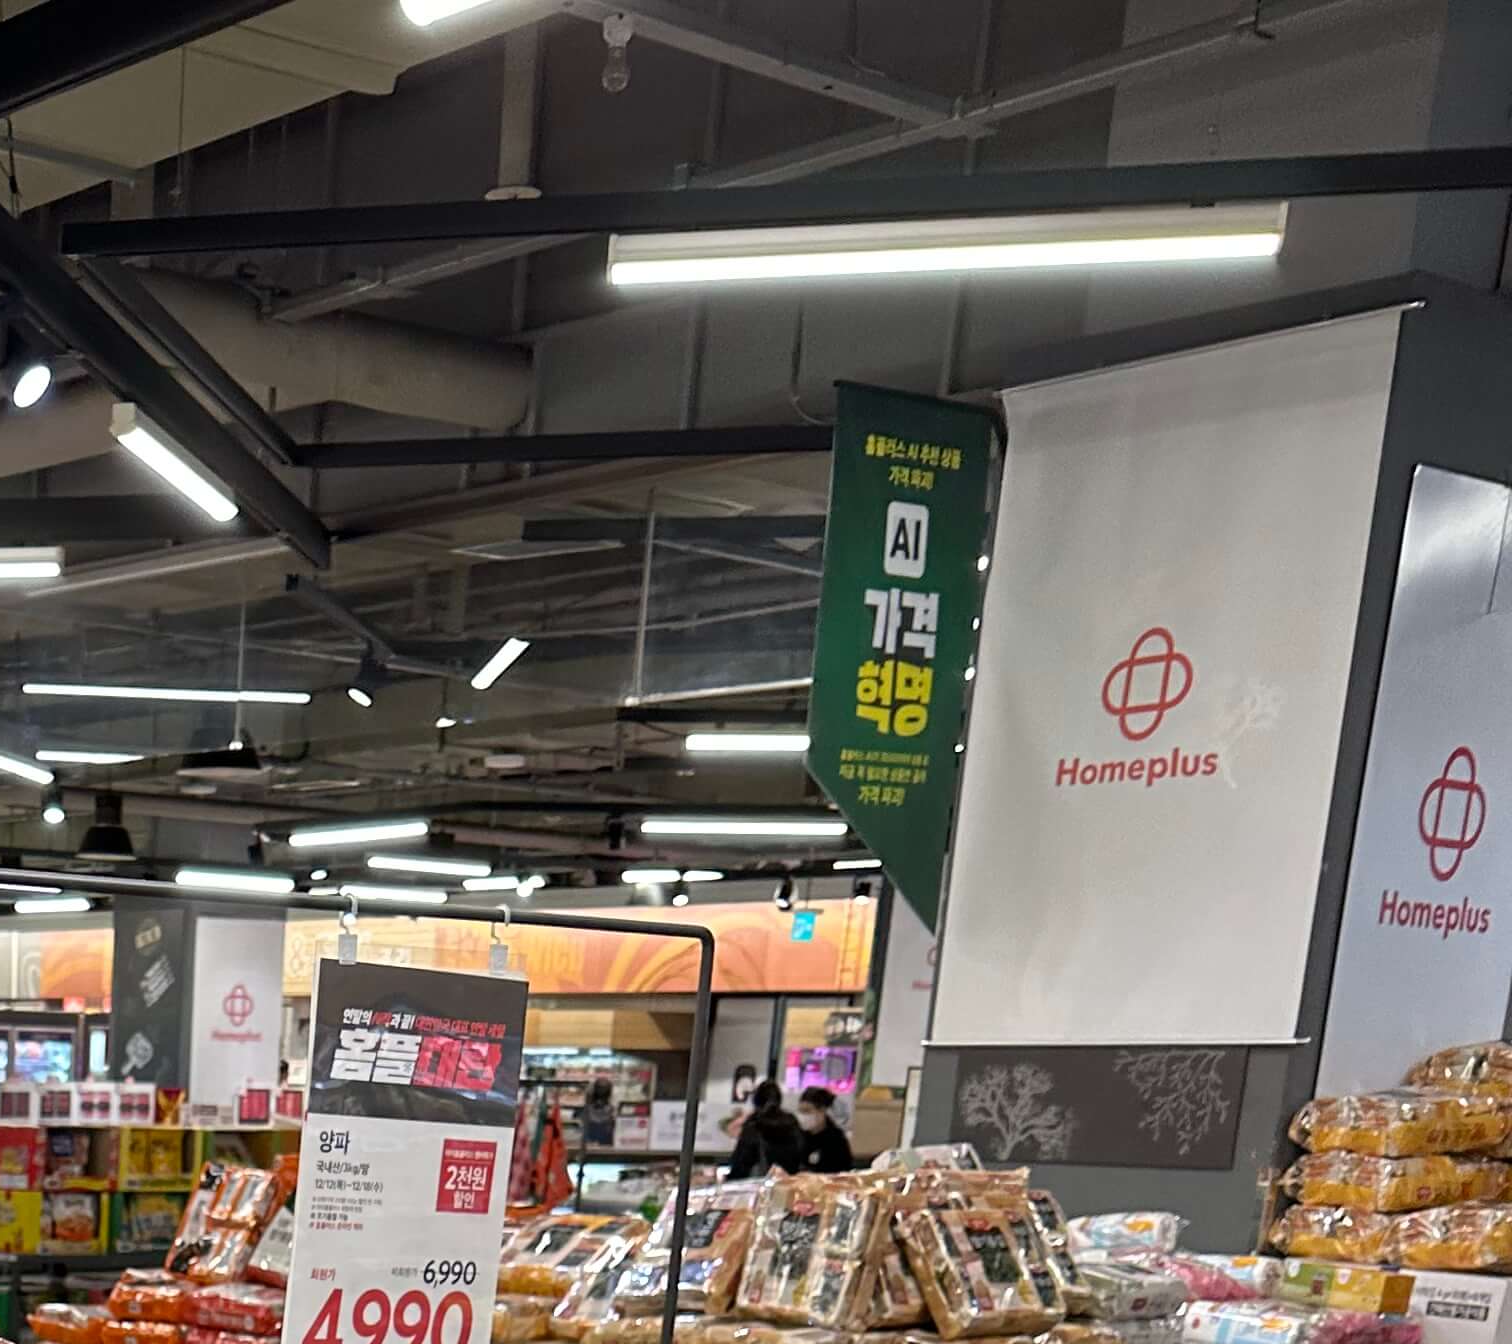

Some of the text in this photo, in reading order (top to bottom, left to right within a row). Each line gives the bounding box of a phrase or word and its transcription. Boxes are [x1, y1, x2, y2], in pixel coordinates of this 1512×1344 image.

[889, 517, 922, 561] AI
[864, 587, 939, 659] 가격
[856, 660, 933, 737] 혁명
[1055, 748, 1219, 788] Homeplus
[1378, 890, 1491, 939] Homeplus
[319, 1130, 351, 1155] 양파
[444, 1165, 488, 1191] 2천원
[453, 1191, 475, 1209] 할인
[423, 1259, 477, 1288] 6,990
